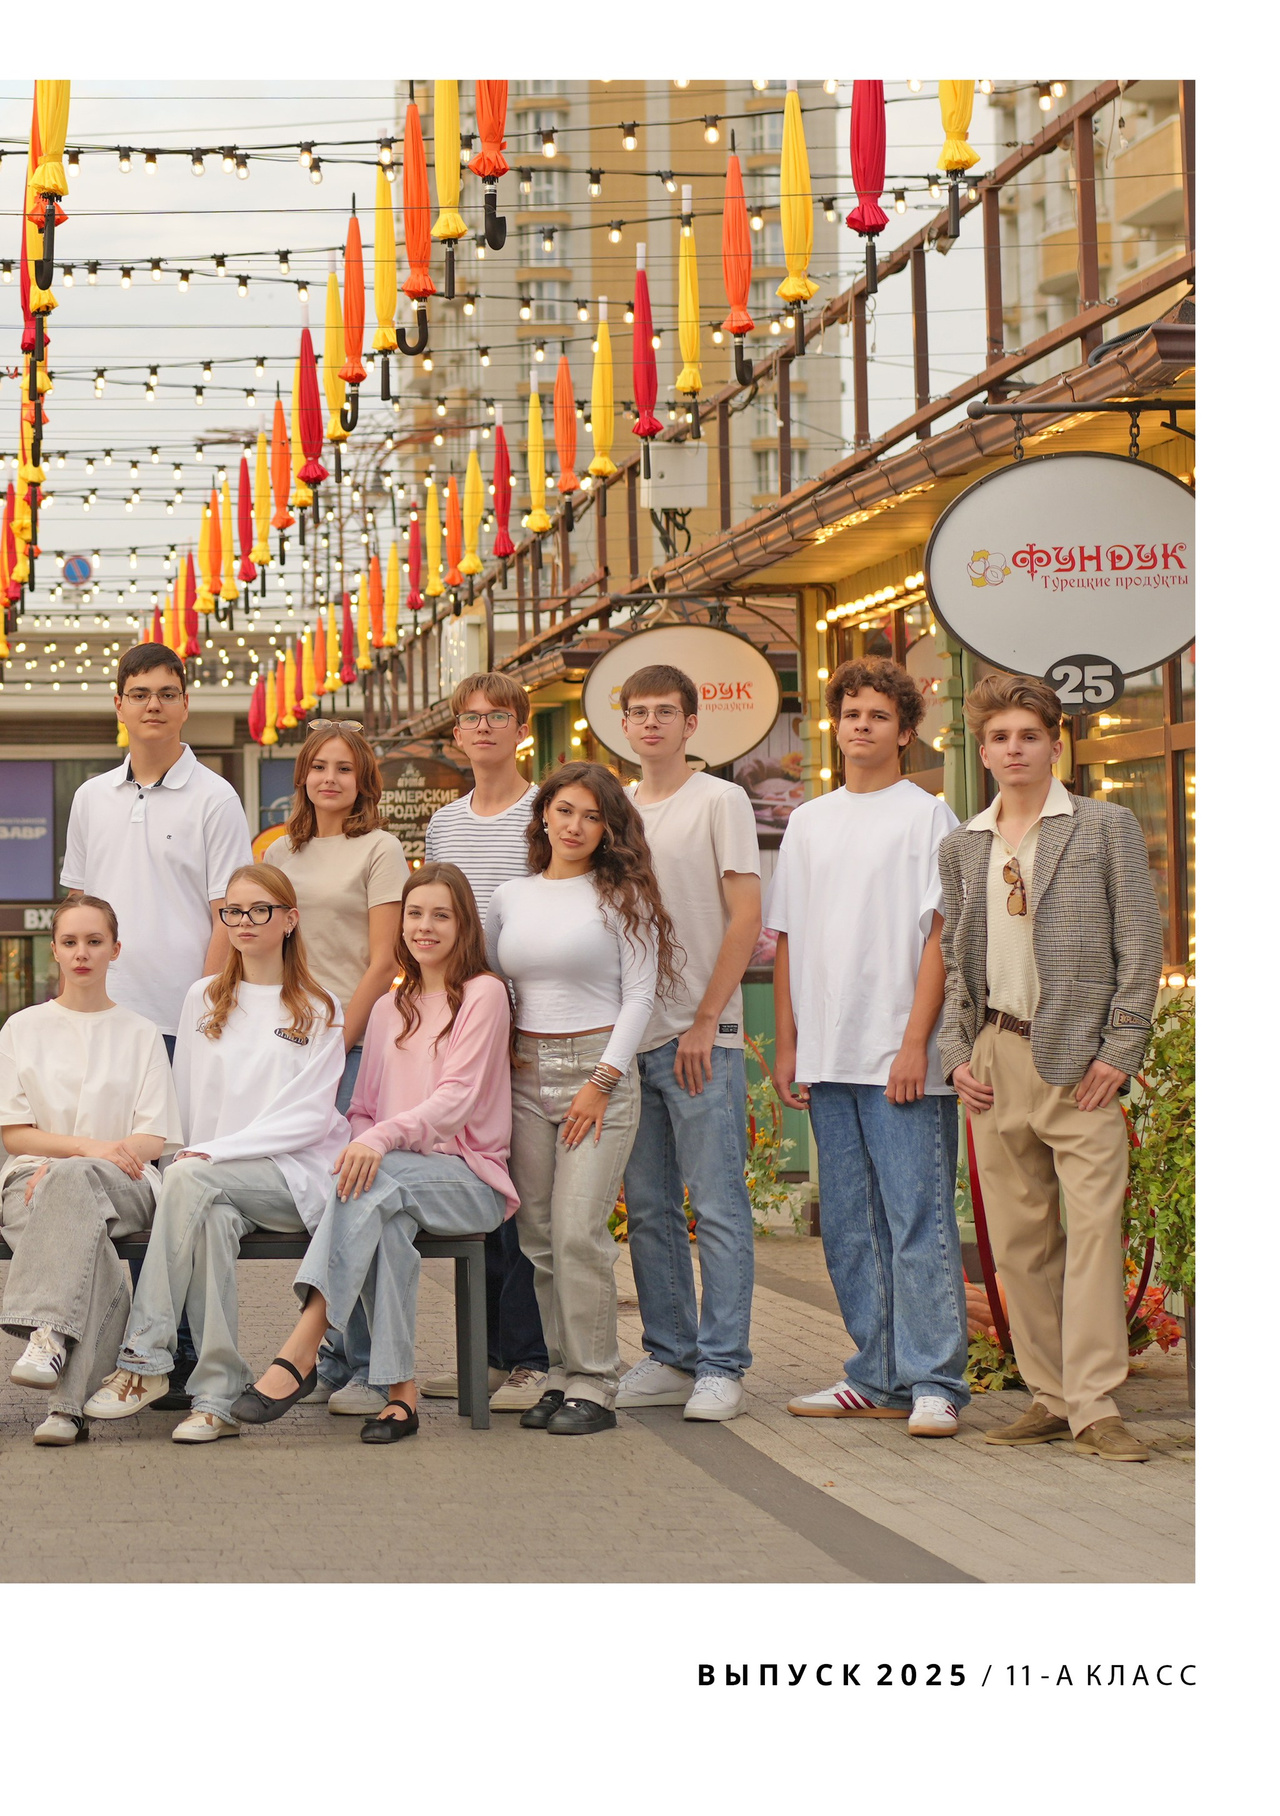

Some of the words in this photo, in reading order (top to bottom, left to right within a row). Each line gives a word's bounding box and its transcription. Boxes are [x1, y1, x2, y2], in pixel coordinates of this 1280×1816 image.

[1012, 542, 1188, 582] ФУНДУК
[1041, 575, 1111, 592] Турецкие
[1115, 573, 1189, 591] продукты
[696, 681, 753, 700] ДУК
[1051, 664, 1116, 704] 25
[381, 788, 459, 803] ЕРМЕРСКИЕ
[402, 840, 425, 857] 22
